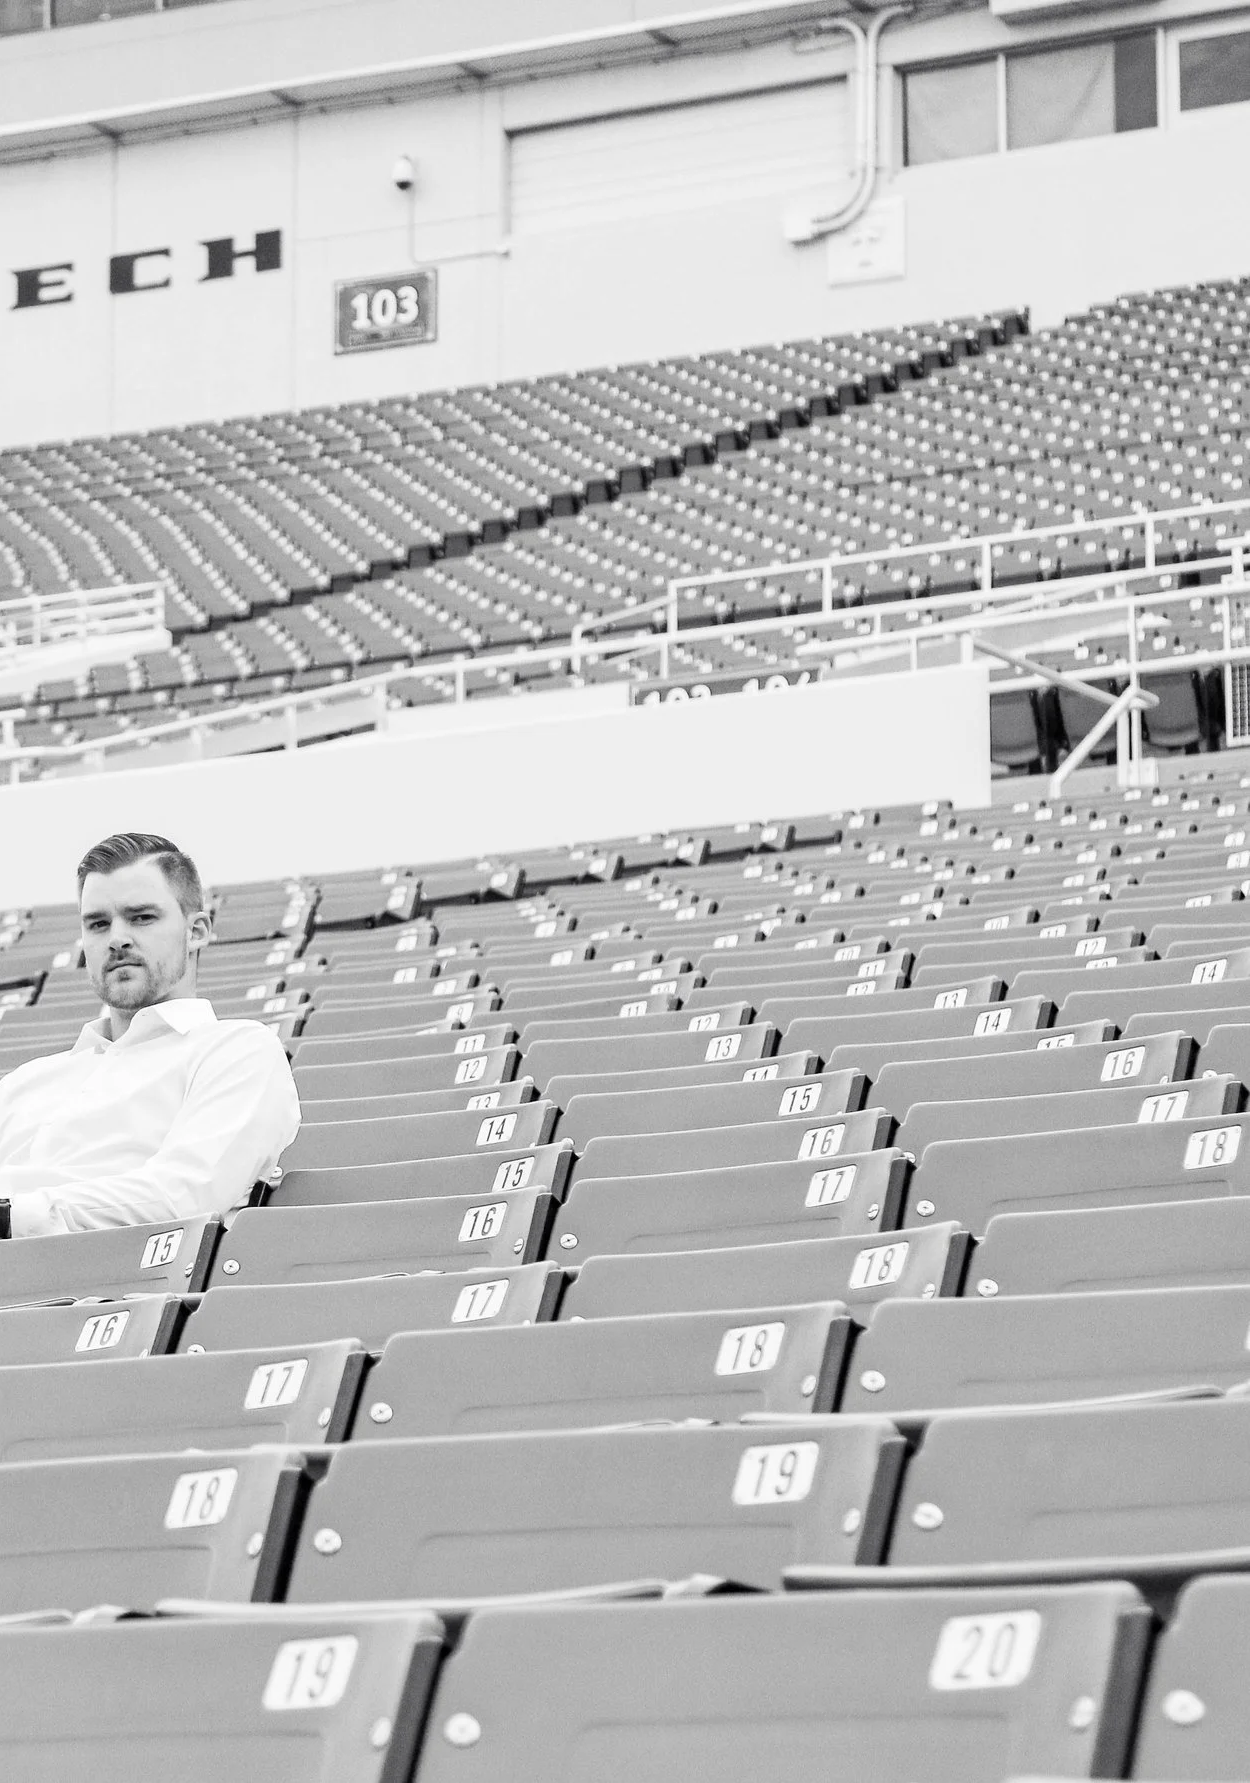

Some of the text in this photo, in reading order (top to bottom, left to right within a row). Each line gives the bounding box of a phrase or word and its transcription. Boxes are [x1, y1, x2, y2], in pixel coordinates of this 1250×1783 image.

[350, 285, 419, 330] 103
[1083, 940, 1099, 954] 12
[866, 964, 878, 975] 11
[1200, 963, 1217, 982] 14
[627, 1005, 640, 1016] 11
[697, 1016, 712, 1030] 12
[983, 1012, 1001, 1033] 14
[462, 1038, 477, 1052] 11
[715, 1038, 732, 1058] 13
[463, 1059, 480, 1080] 12
[1111, 1051, 1135, 1078] 16
[789, 1087, 812, 1113] 15
[1152, 1097, 1177, 1122] 17
[486, 1118, 507, 1142] 14
[808, 1129, 833, 1158] 16
[1198, 1131, 1228, 1165] 18
[501, 1161, 526, 1189] 15
[818, 1171, 846, 1203] 17
[468, 1207, 497, 1238] 16
[150, 1234, 175, 1265] 15
[863, 1248, 895, 1284] 18
[466, 1285, 497, 1318] 17
[86, 1315, 118, 1348] 16
[732, 1329, 768, 1370] 18
[260, 1366, 294, 1404] 17
[754, 1450, 799, 1497] 19
[182, 1476, 220, 1521] 18
[952, 1622, 1018, 1681] 20
[286, 1646, 336, 1701] 19
